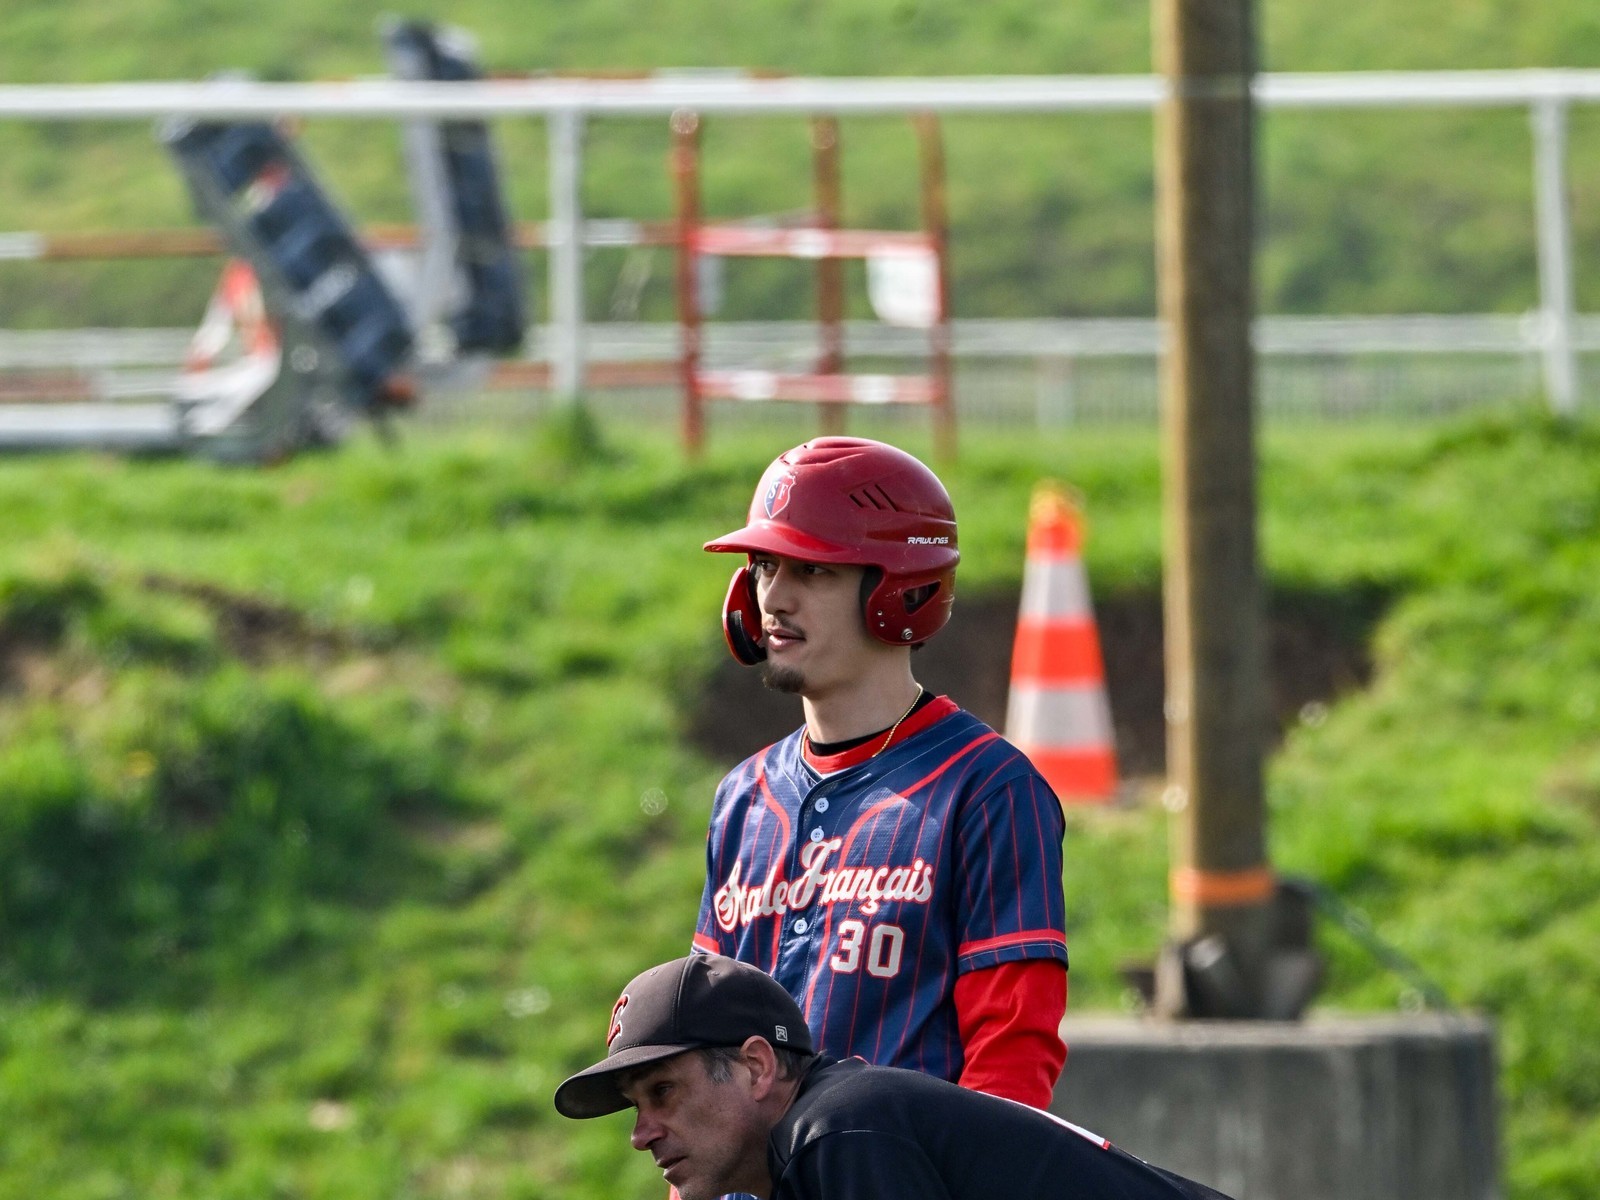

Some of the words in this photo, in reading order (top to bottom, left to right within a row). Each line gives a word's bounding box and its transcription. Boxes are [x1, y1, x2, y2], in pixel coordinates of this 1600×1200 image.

[907, 536, 949, 545] RAWLINGS
[713, 857, 789, 933] Stade
[787, 836, 933, 916] Français
[829, 919, 905, 979] 30
